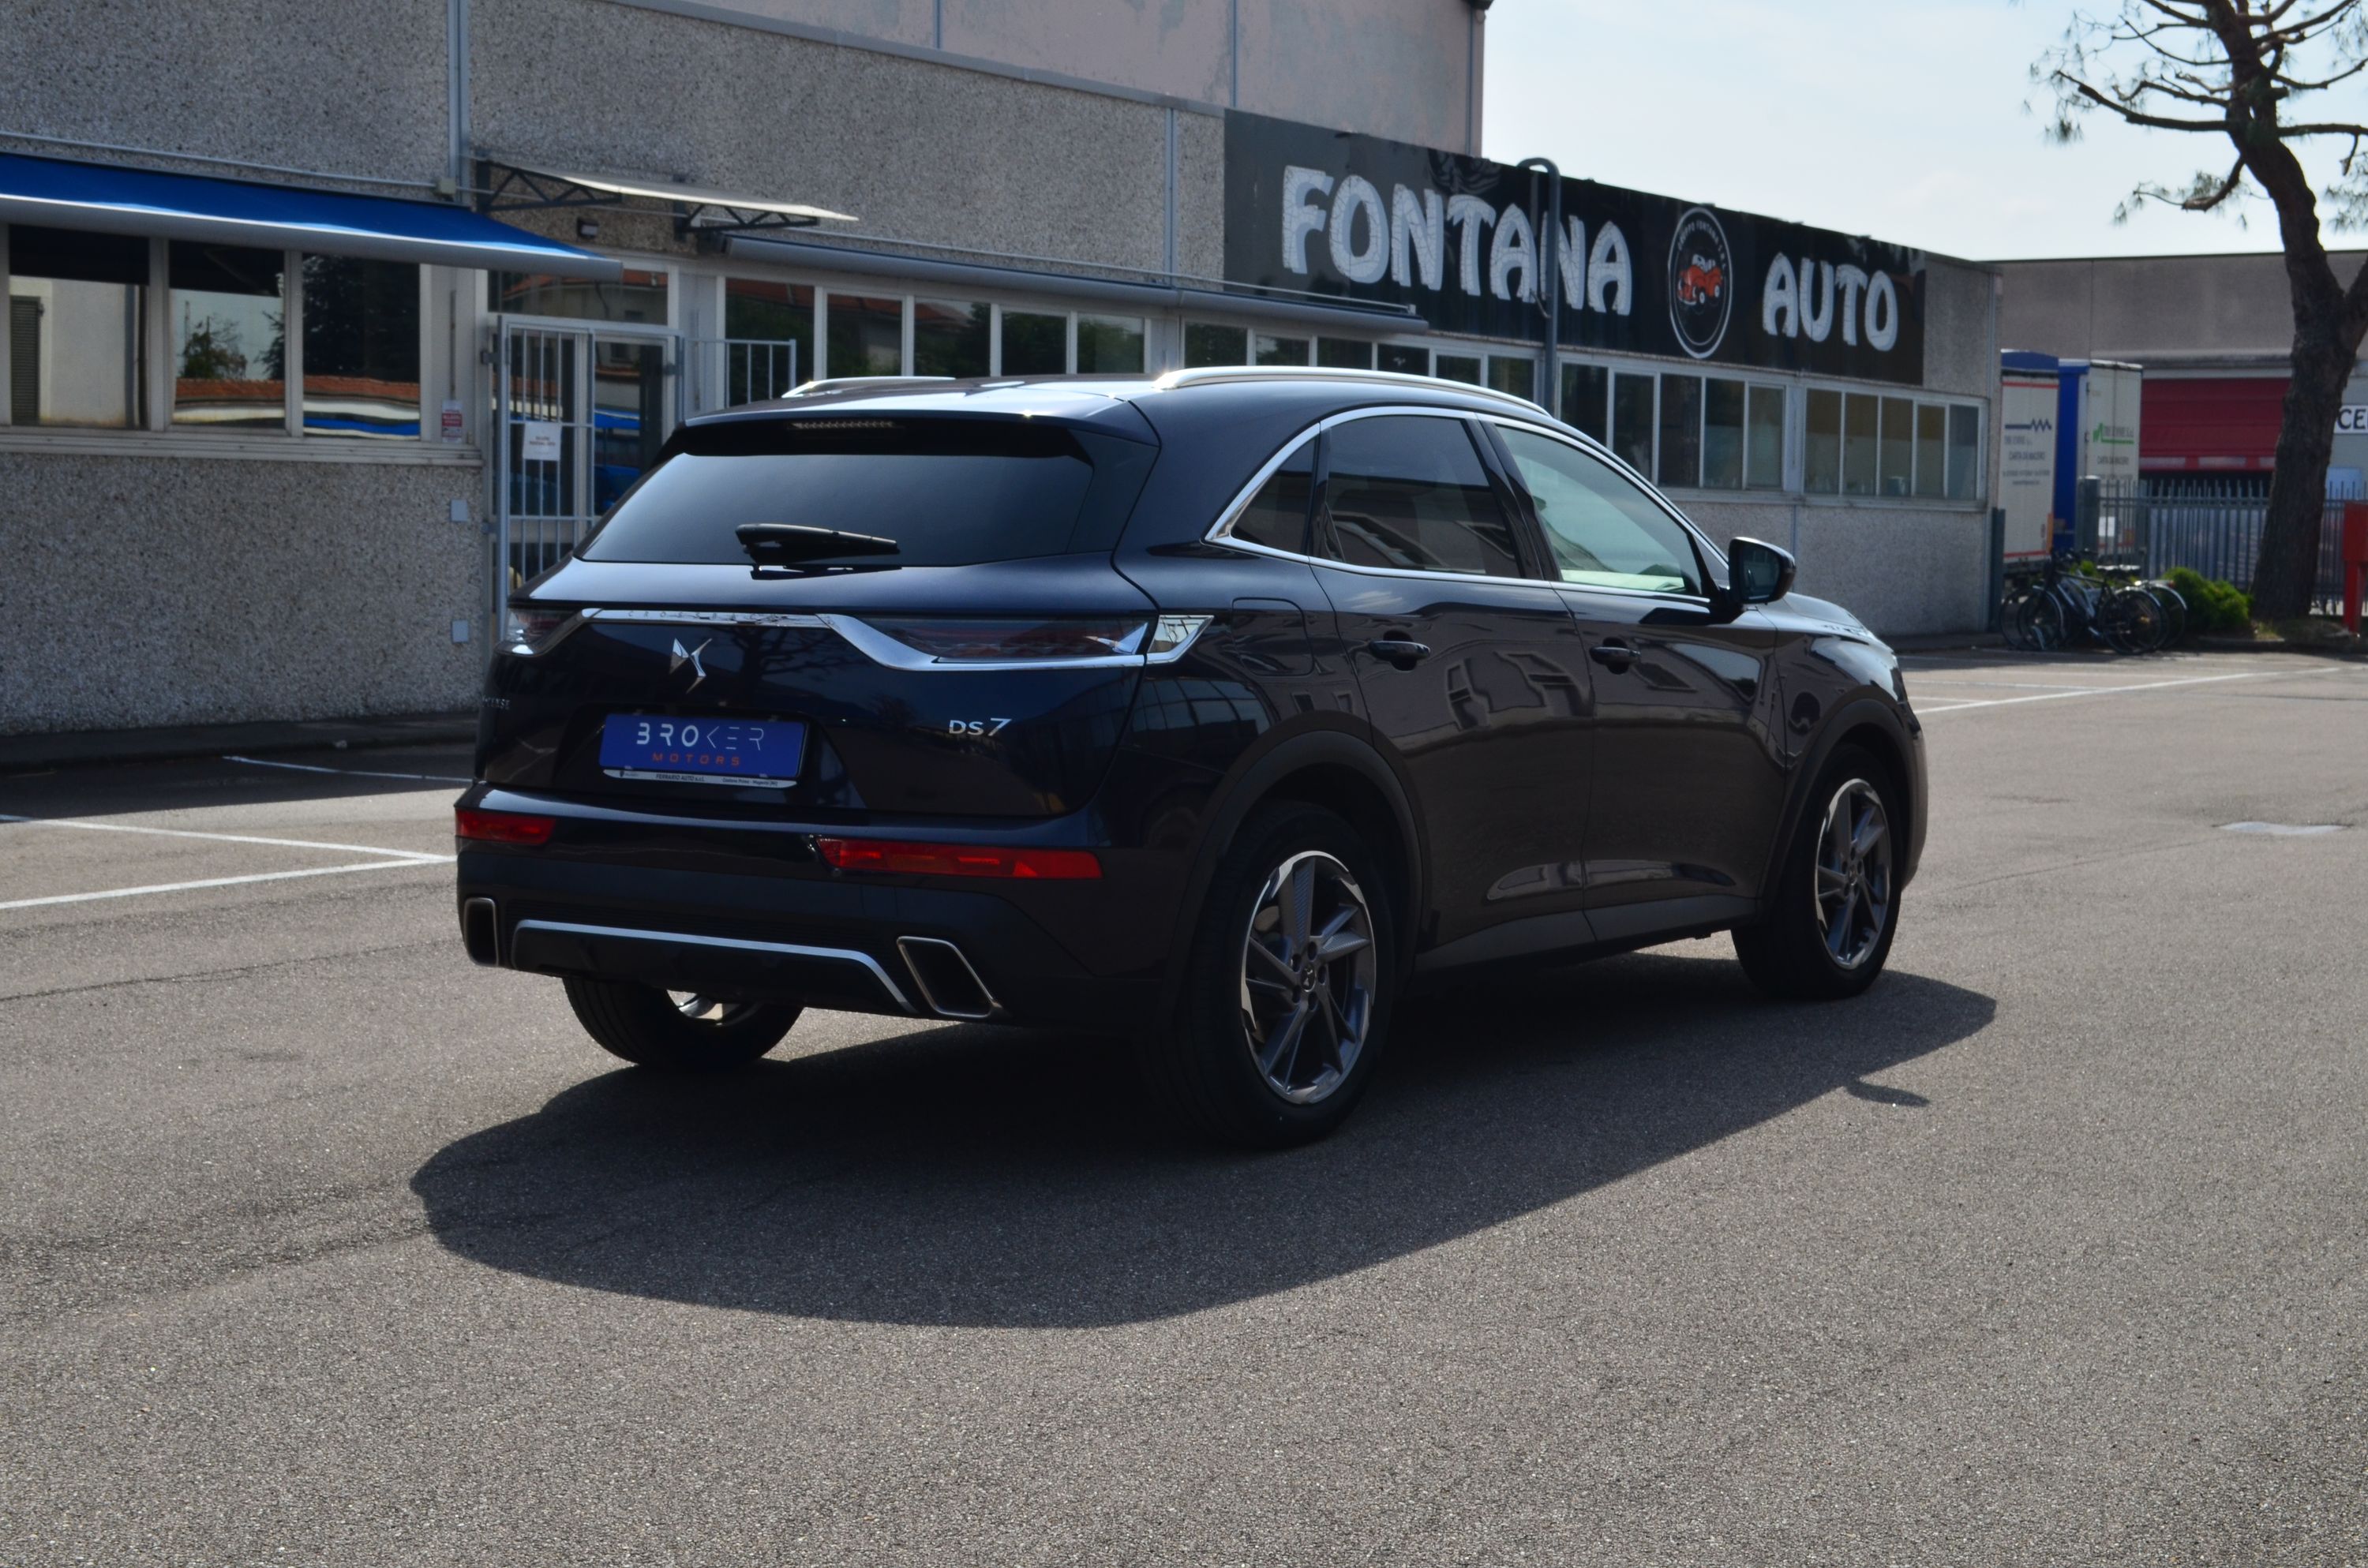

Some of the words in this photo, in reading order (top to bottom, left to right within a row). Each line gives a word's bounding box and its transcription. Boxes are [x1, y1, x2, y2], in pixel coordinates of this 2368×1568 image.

[1282, 165, 1632, 316] FONTANA
[1763, 252, 1898, 352] AUTO
[2338, 408, 2368, 430] CE
[636, 723, 764, 750] BROKER
[652, 752, 741, 766] MOTORS
